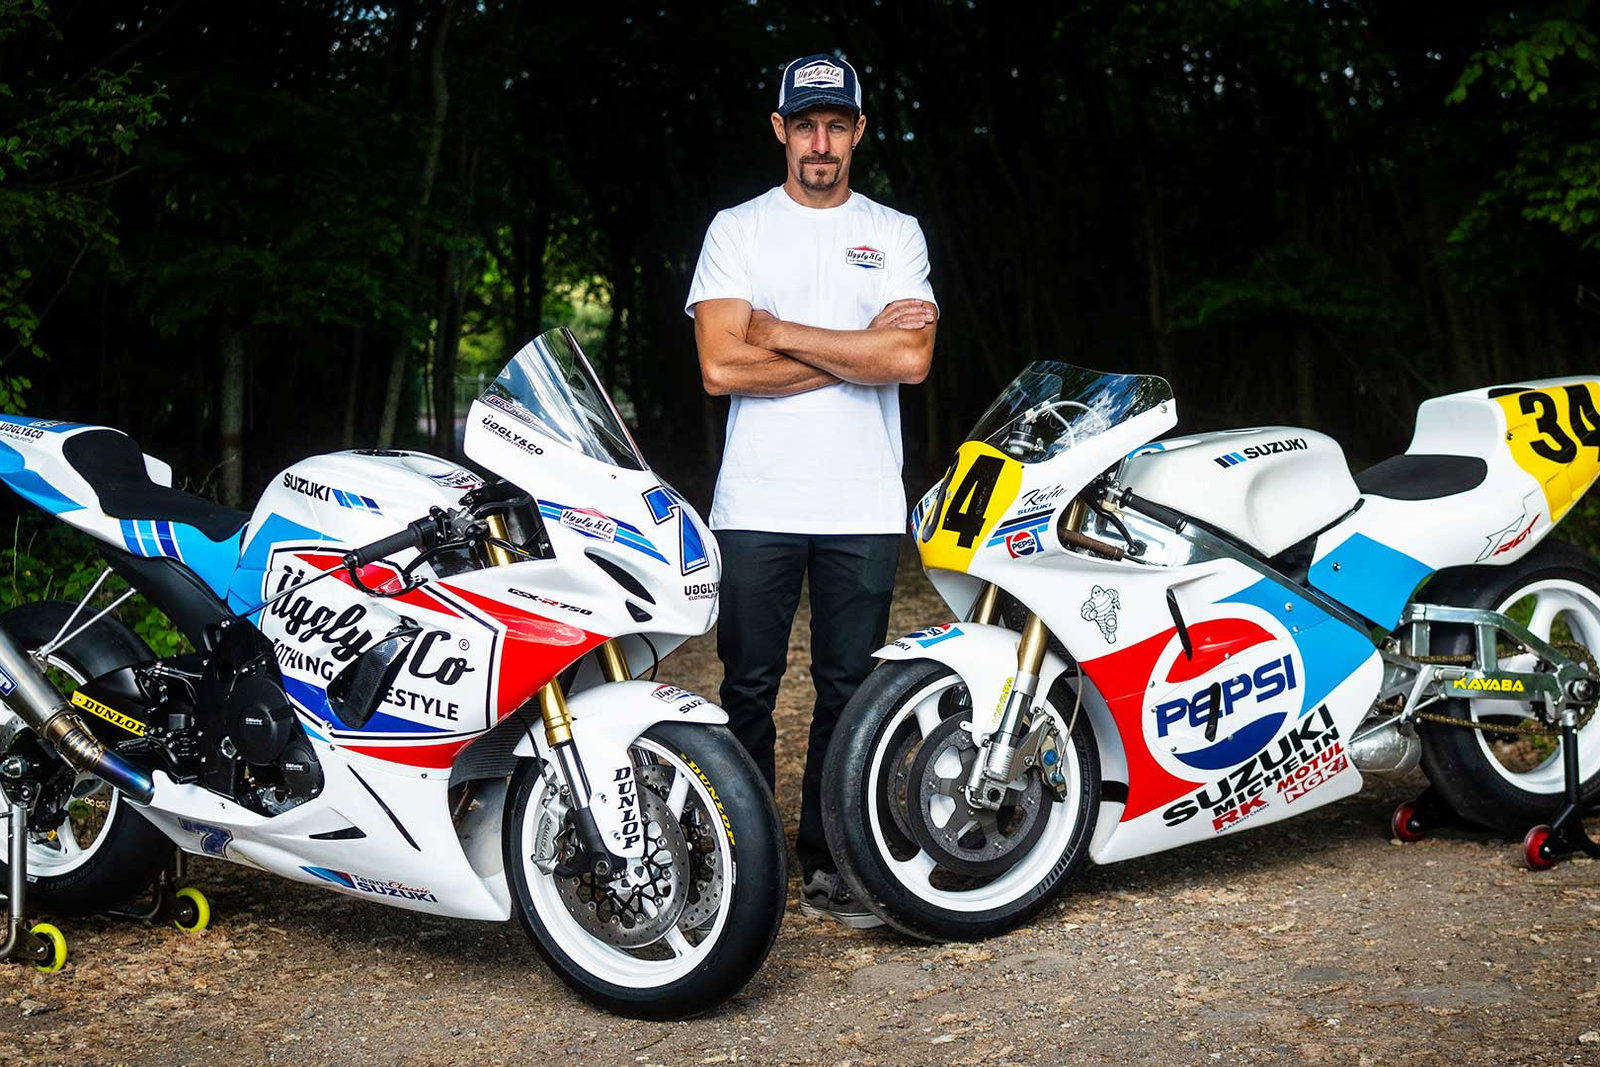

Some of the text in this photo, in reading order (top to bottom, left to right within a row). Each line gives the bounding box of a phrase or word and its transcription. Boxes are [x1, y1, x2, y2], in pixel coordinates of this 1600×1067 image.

[1519, 384, 1600, 464] 34
[1243, 438, 1308, 460] SUZUKI
[283, 472, 331, 502] SUZUKI
[1017, 502, 1052, 516] SUZUKI
[642, 485, 710, 577] 7
[1011, 538, 1036, 550] PEPSI
[274, 638, 334, 682] OTHING
[382, 687, 460, 722] ESTYLE
[1155, 654, 1297, 738] PEPSI
[1162, 703, 1335, 828] SUZUKI
[1213, 726, 1340, 818] MICHELIN
[1276, 741, 1344, 794] MOTUL
[1284, 755, 1346, 804] NGK
[613, 766, 643, 850] DUNLOP
[688, 760, 736, 846] DUNLOP
[1212, 791, 1268, 831] RK
[351, 874, 389, 888] Team
[356, 881, 439, 903] SUZUKI
